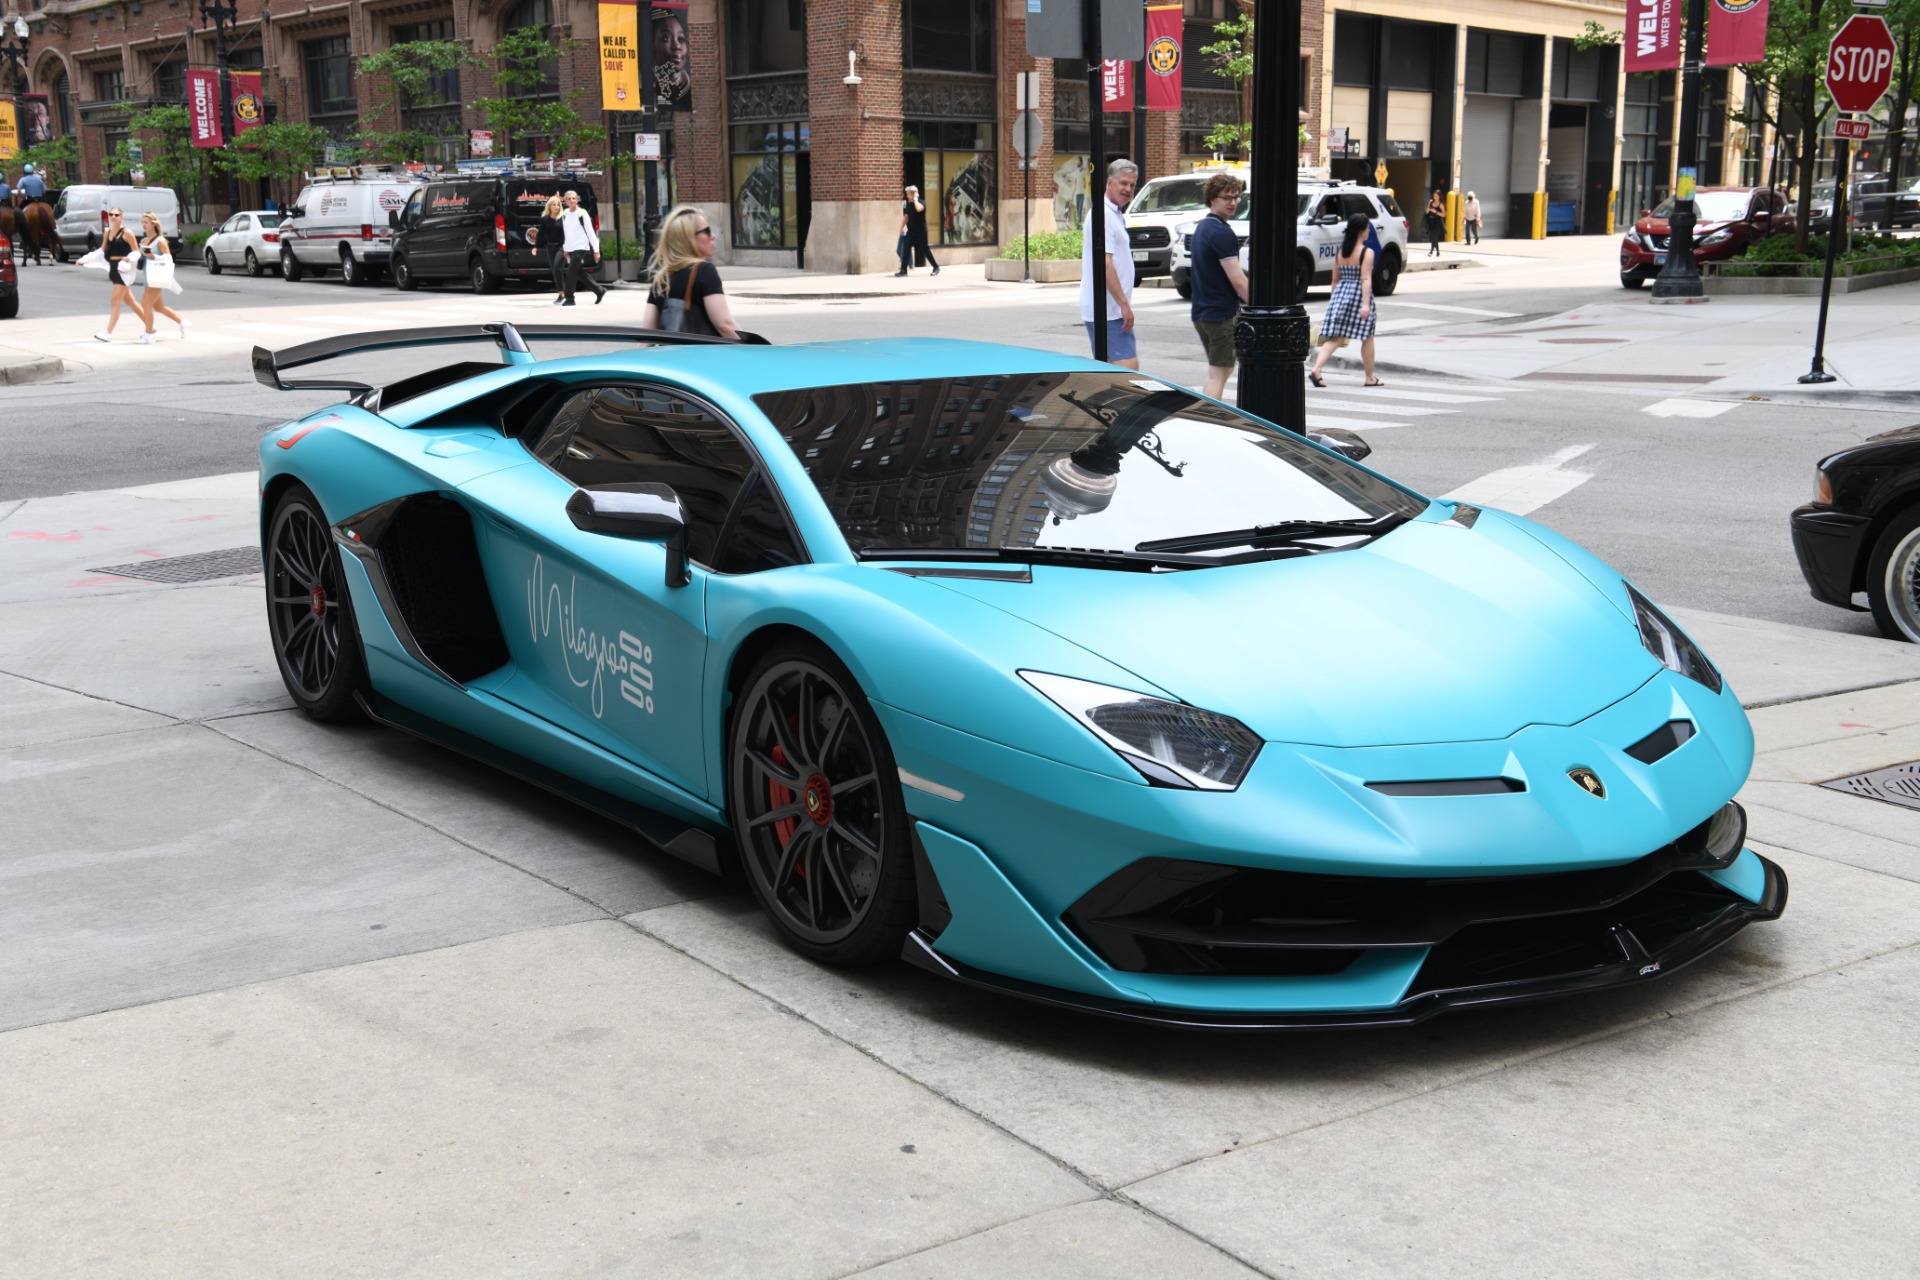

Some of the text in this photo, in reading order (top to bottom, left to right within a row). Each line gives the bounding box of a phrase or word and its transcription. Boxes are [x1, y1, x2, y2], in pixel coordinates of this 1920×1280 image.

[1660, 17, 1670, 48] WATER
[603, 36, 627, 47] WE ARE
[603, 48, 636, 59] CALLED TO
[604, 61, 624, 71] SOLVE
[1830, 45, 1891, 83] STOP
[194, 78, 210, 140] WELCOME
[1838, 123, 1867, 137] ALL WAY
[384, 198, 407, 206] AMS
